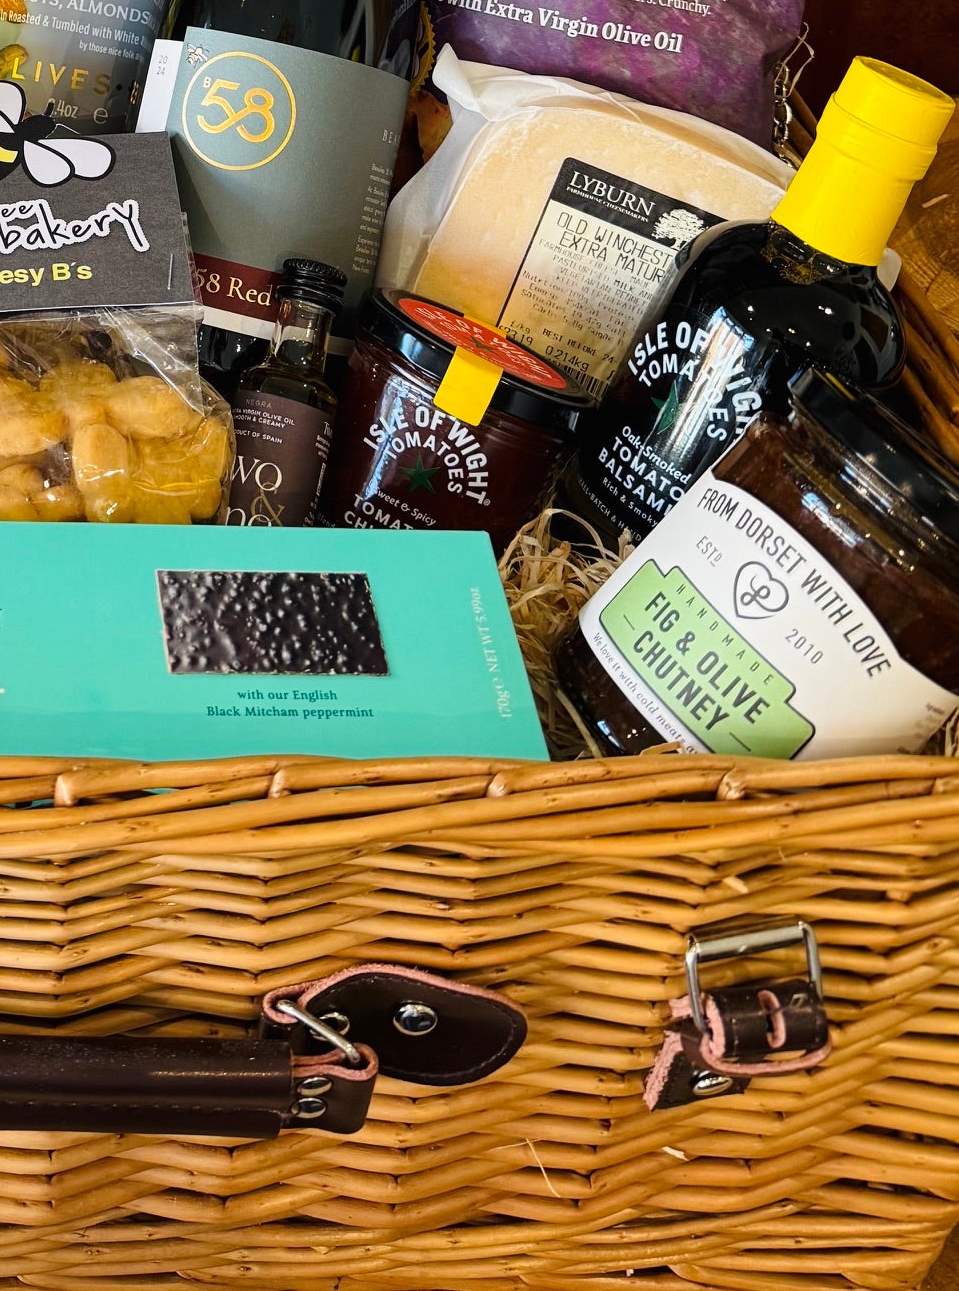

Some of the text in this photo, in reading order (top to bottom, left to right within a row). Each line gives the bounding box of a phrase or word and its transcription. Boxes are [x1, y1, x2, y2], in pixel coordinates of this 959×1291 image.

[9, 10, 140, 45] Roasted Tumbled with White
[539, 7, 598, 40] Virgin
[602, 21, 651, 48] Olive
[654, 30, 683, 54] Oil
[569, 170, 656, 216] LYBURN
[556, 211, 588, 235] OLD
[559, 233, 607, 261] EXTRA
[195, 268, 273, 307] 58 Red
[627, 321, 709, 376] ISLE OF
[245, 398, 272, 409] NEGRA
[258, 418, 285, 429] CREAMY
[363, 405, 490, 505] ISLE OF WIGHT
[385, 430, 465, 496] TOMATOES
[622, 425, 692, 484] Oak-Smoked
[697, 488, 892, 677] FROM DORSET WITH LOVE
[644, 590, 771, 725] FIG & OLIVE
[676, 584, 775, 686] HANDMADE
[237, 688, 338, 703] with our English
[633, 630, 731, 732] CHUTNEY
[207, 705, 375, 720] Black Mitcham peppermint
